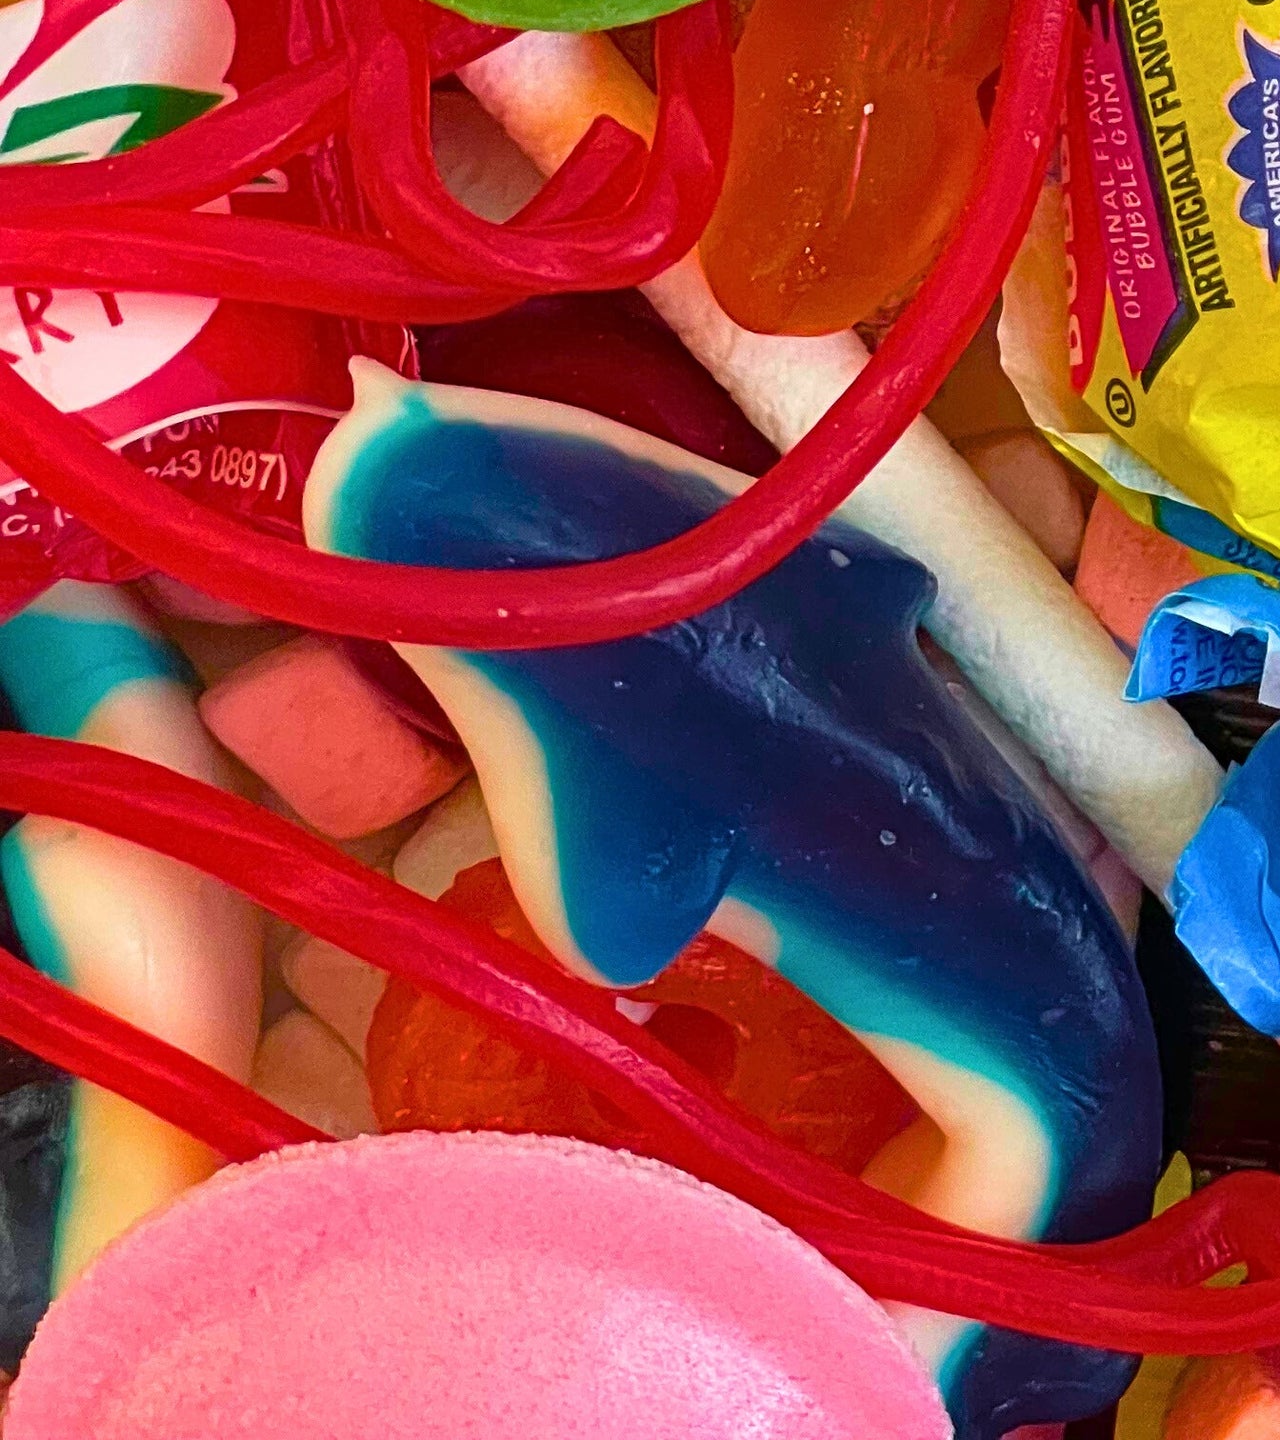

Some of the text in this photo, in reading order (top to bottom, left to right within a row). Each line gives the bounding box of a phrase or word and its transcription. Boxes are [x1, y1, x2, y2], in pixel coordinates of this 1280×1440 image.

[1100, 72, 1156, 270] BUBBLE GUM
[1100, 180, 1141, 319] ORIGINAL
[1152, 120, 1236, 312] ARTIFICIALLY
[210, 444, 287, 501] 0897)
